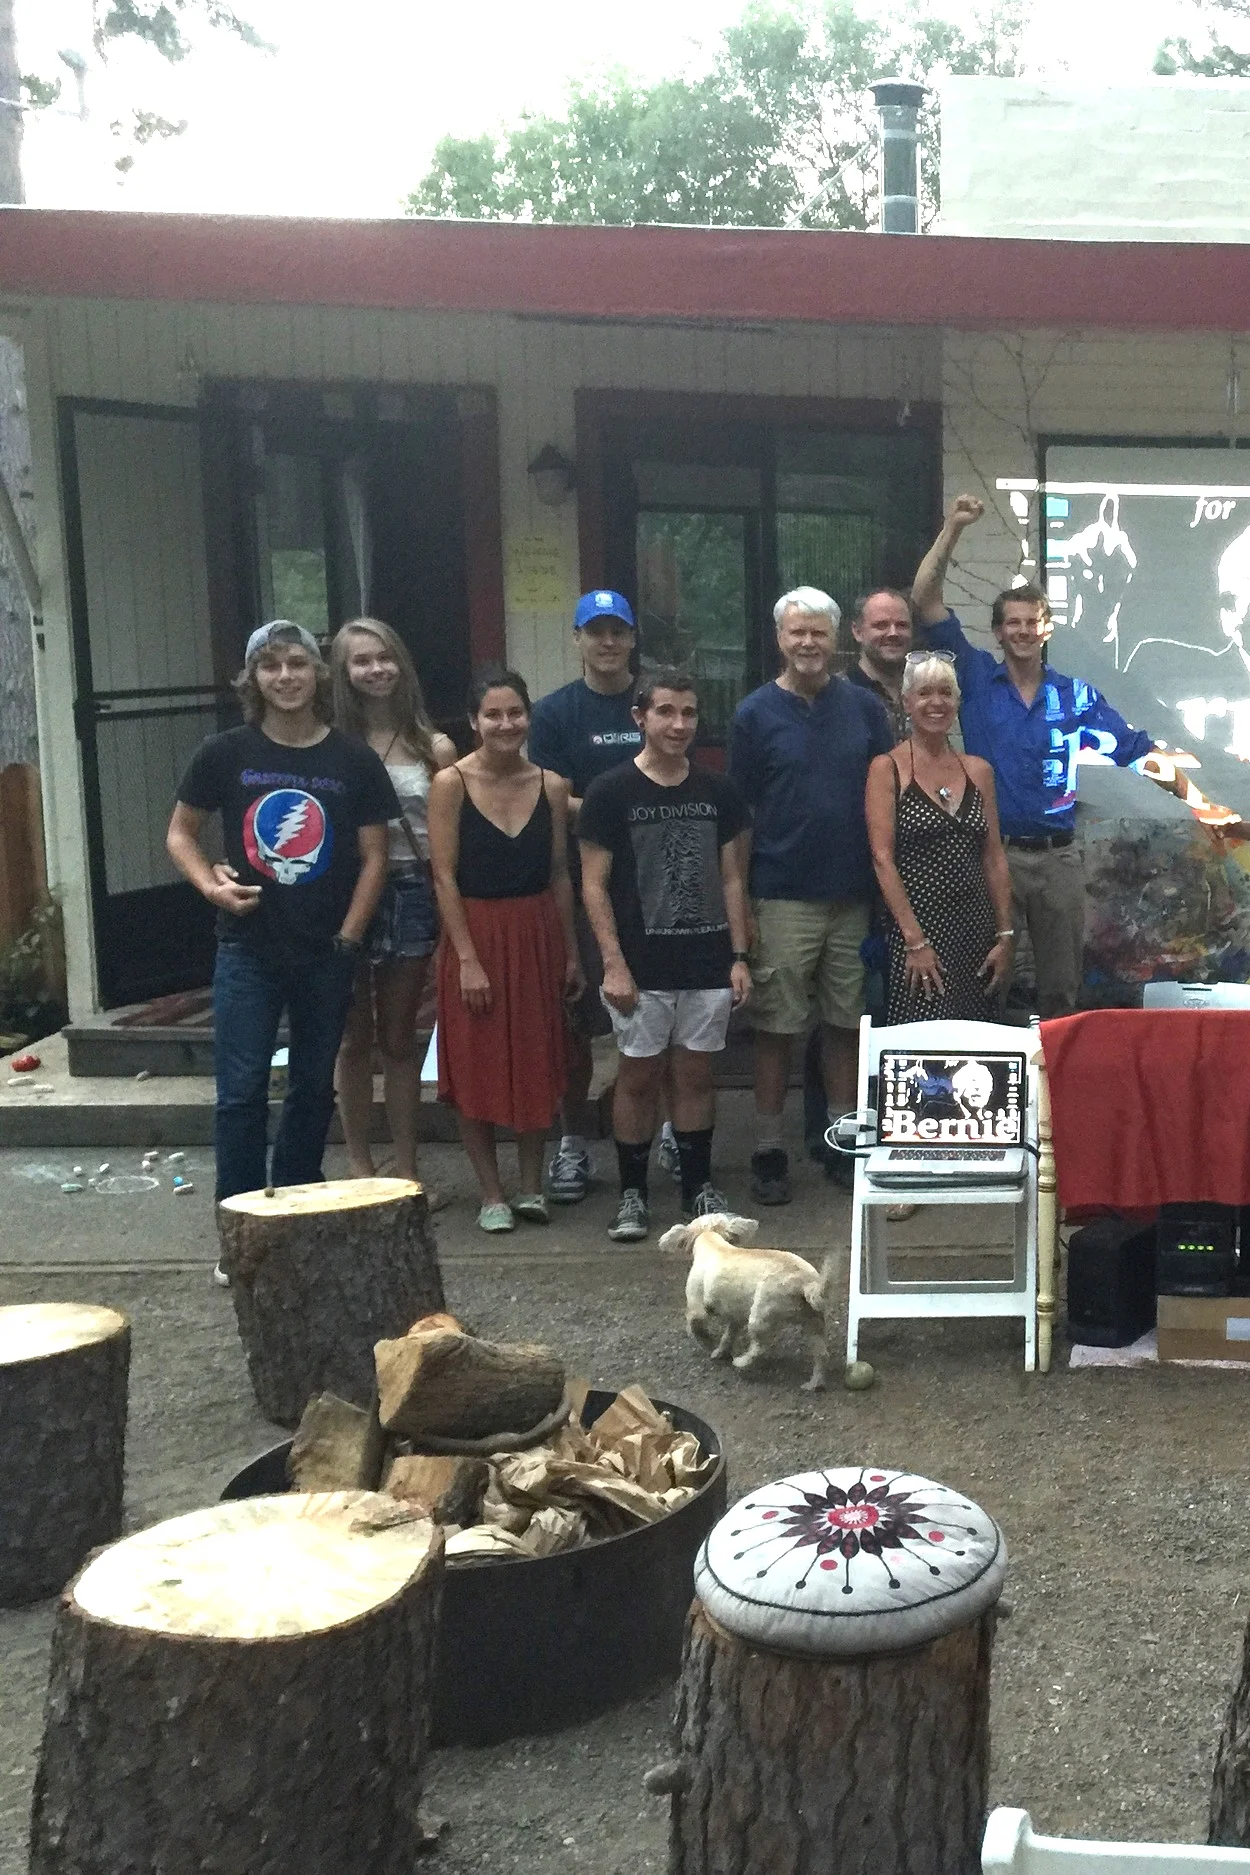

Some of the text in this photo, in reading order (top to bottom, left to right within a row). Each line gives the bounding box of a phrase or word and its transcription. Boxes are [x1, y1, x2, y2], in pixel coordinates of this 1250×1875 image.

[1190, 497, 1236, 528] for
[628, 803, 717, 821] JOY DIVISION
[892, 1110, 1017, 1140] Bernie
